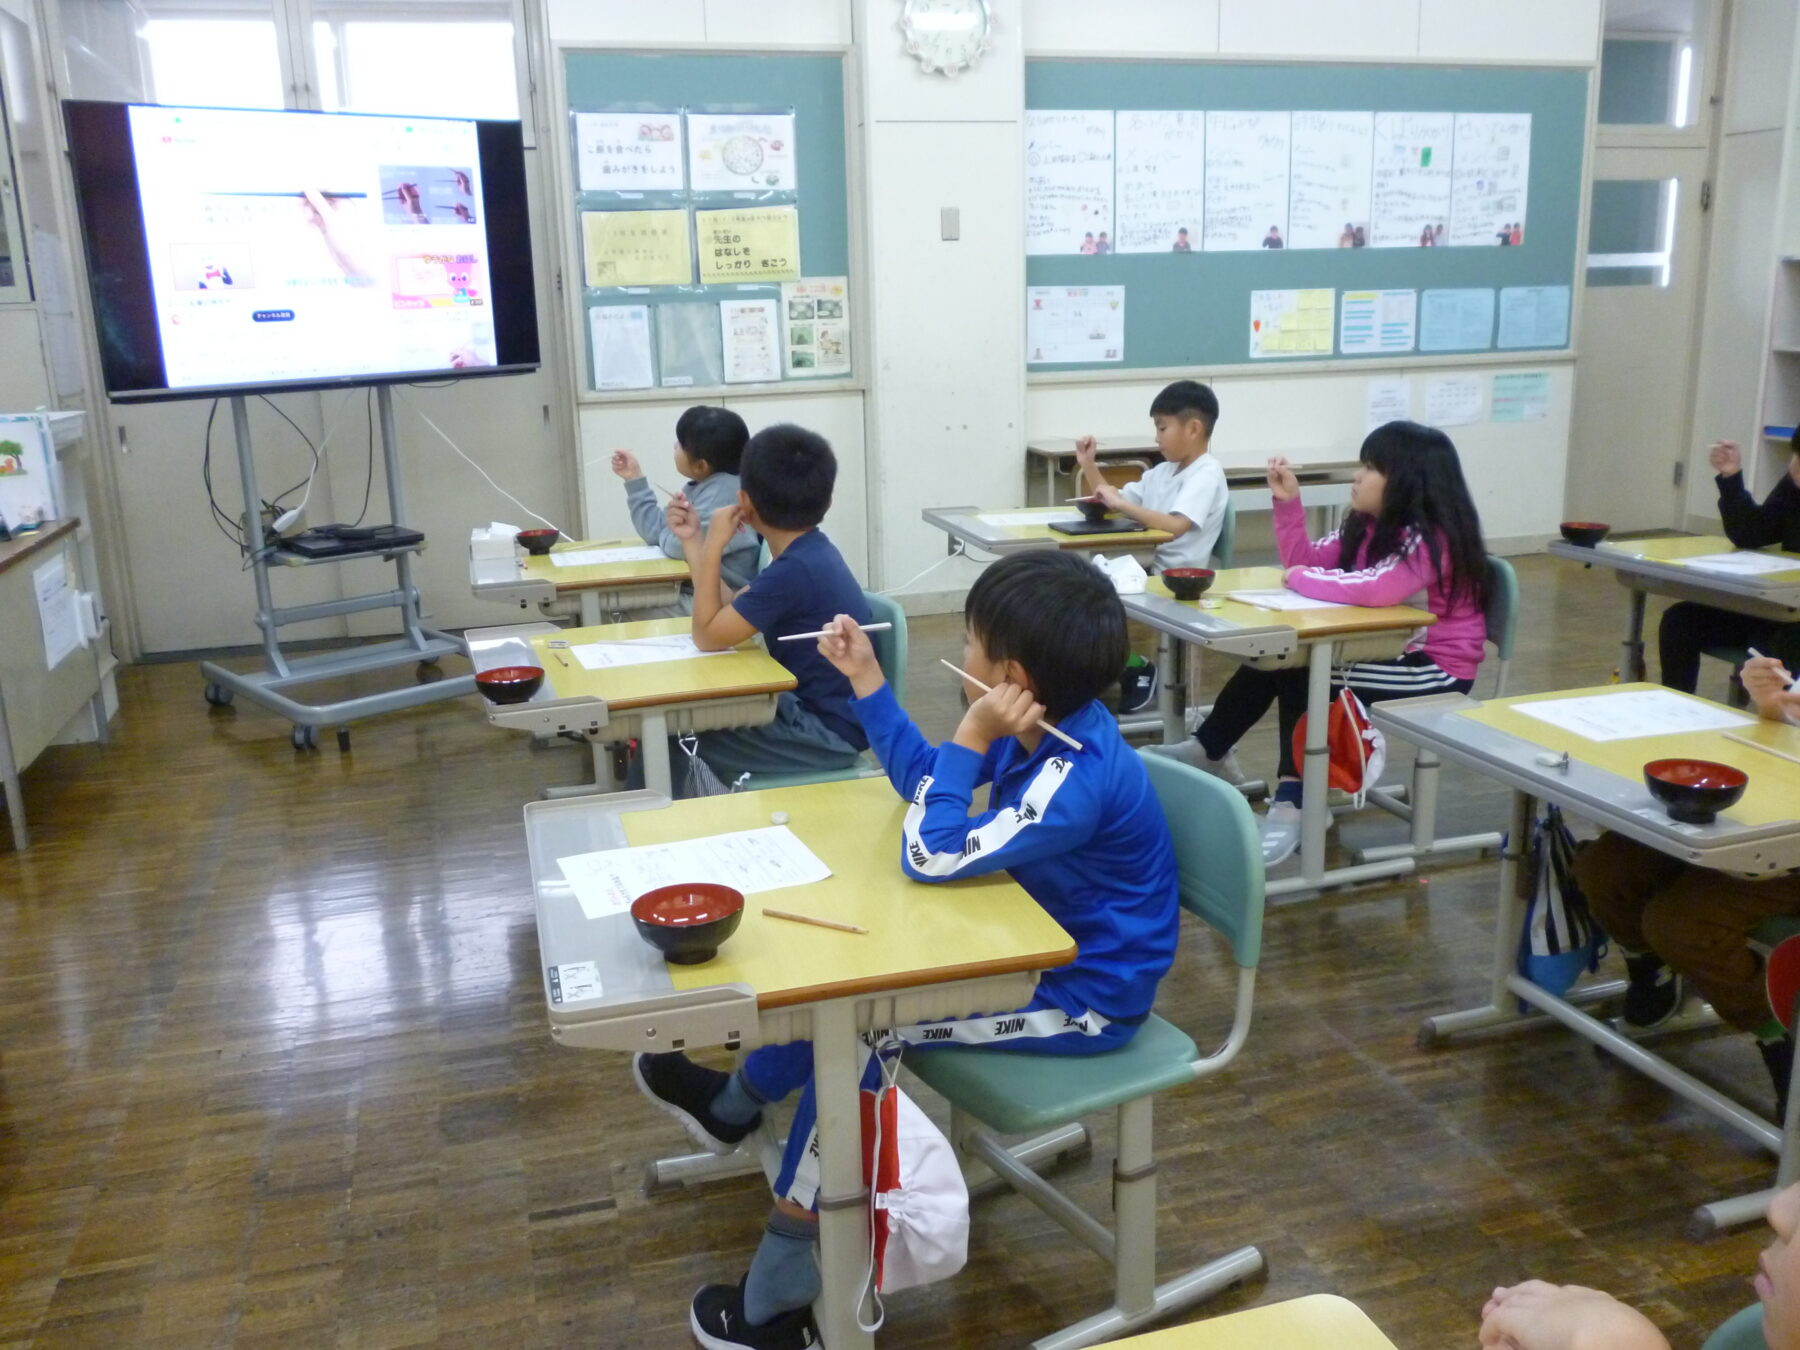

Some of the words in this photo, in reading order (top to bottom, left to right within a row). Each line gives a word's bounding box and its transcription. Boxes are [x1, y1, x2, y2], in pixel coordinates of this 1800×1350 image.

[713, 234, 742, 245] 先生の
[714, 246, 752, 257] はなしを
[715, 259, 752, 270] しっかり
[993, 1018, 1026, 1036] NIKE
[922, 1027, 954, 1041] NIKE
